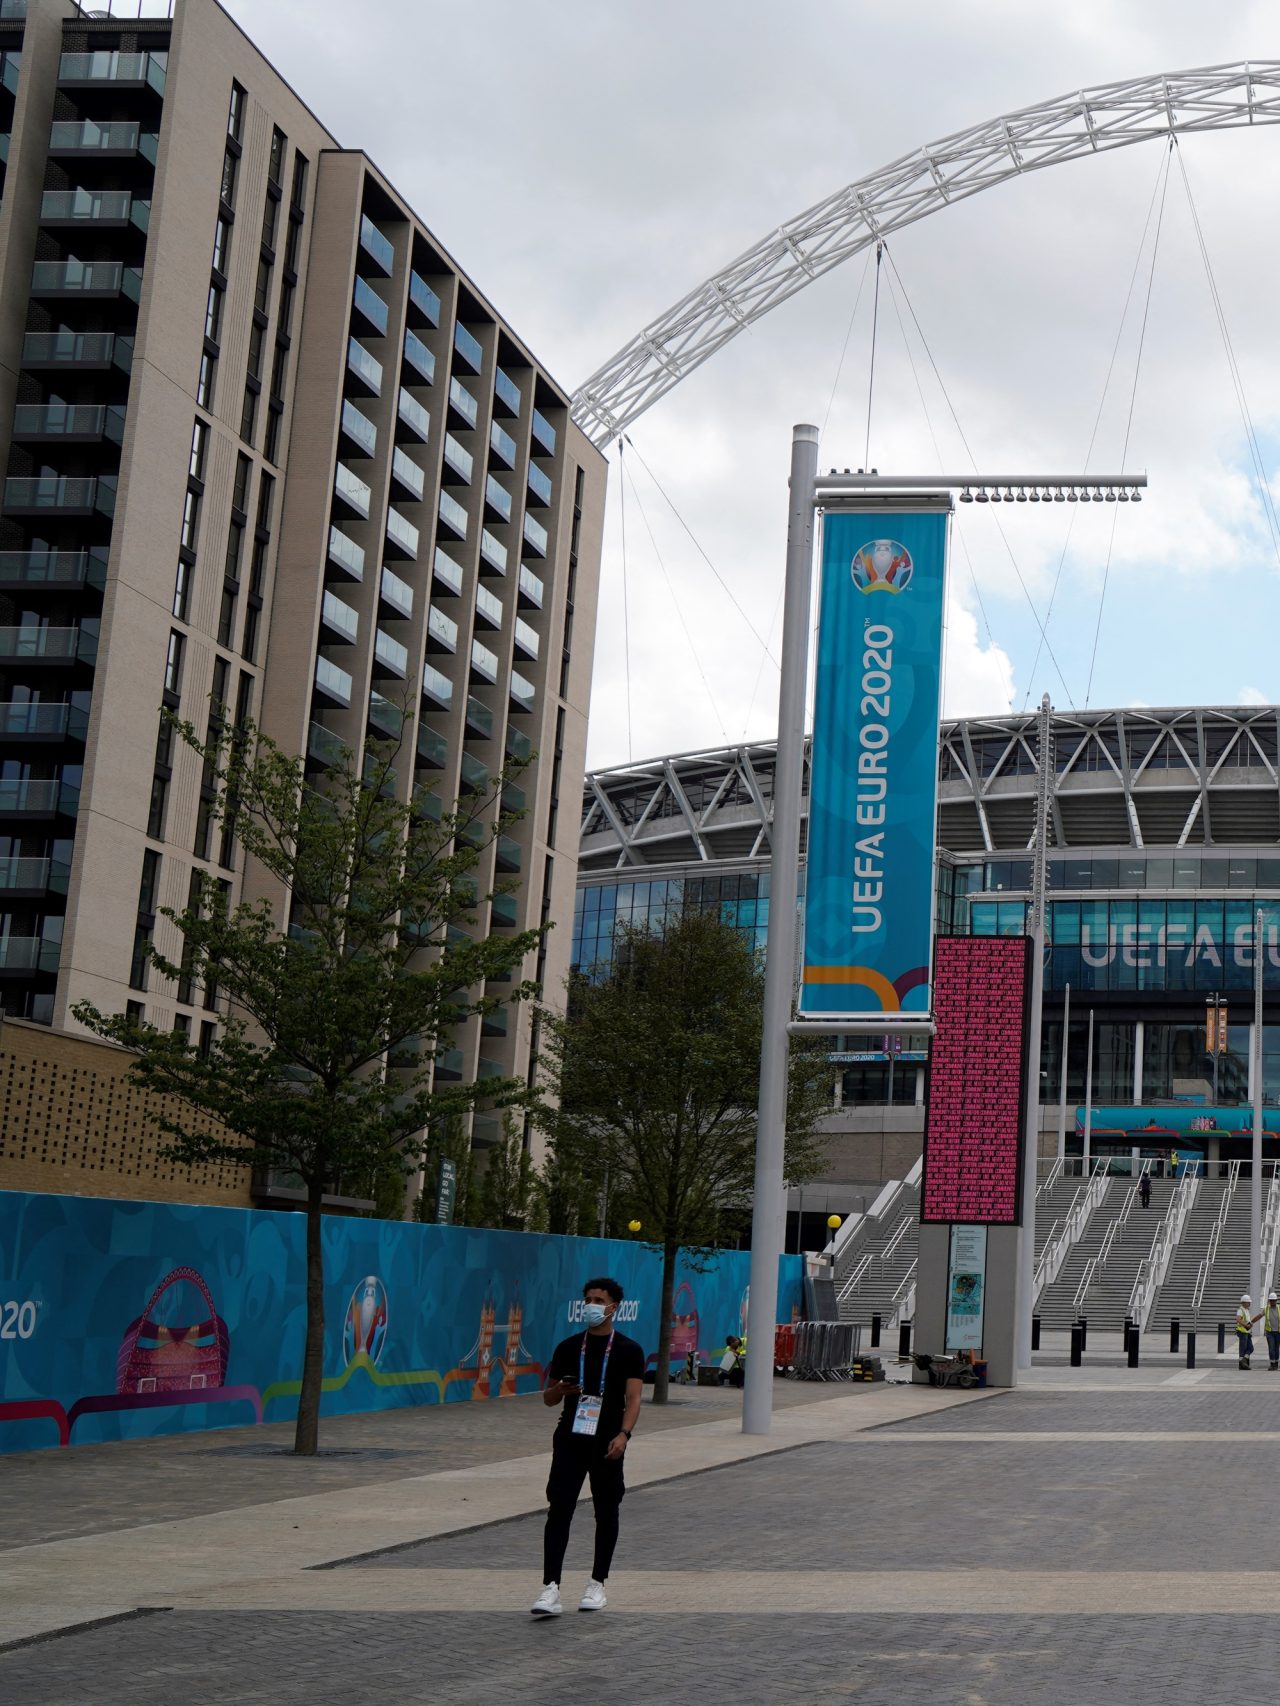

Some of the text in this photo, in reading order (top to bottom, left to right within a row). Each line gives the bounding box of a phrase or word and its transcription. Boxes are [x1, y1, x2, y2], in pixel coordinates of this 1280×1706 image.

[855, 723, 888, 826] EURO
[852, 831, 885, 932] UEFA
[1081, 923, 1222, 968] UEFA
[0, 1300, 36, 1339] 20
